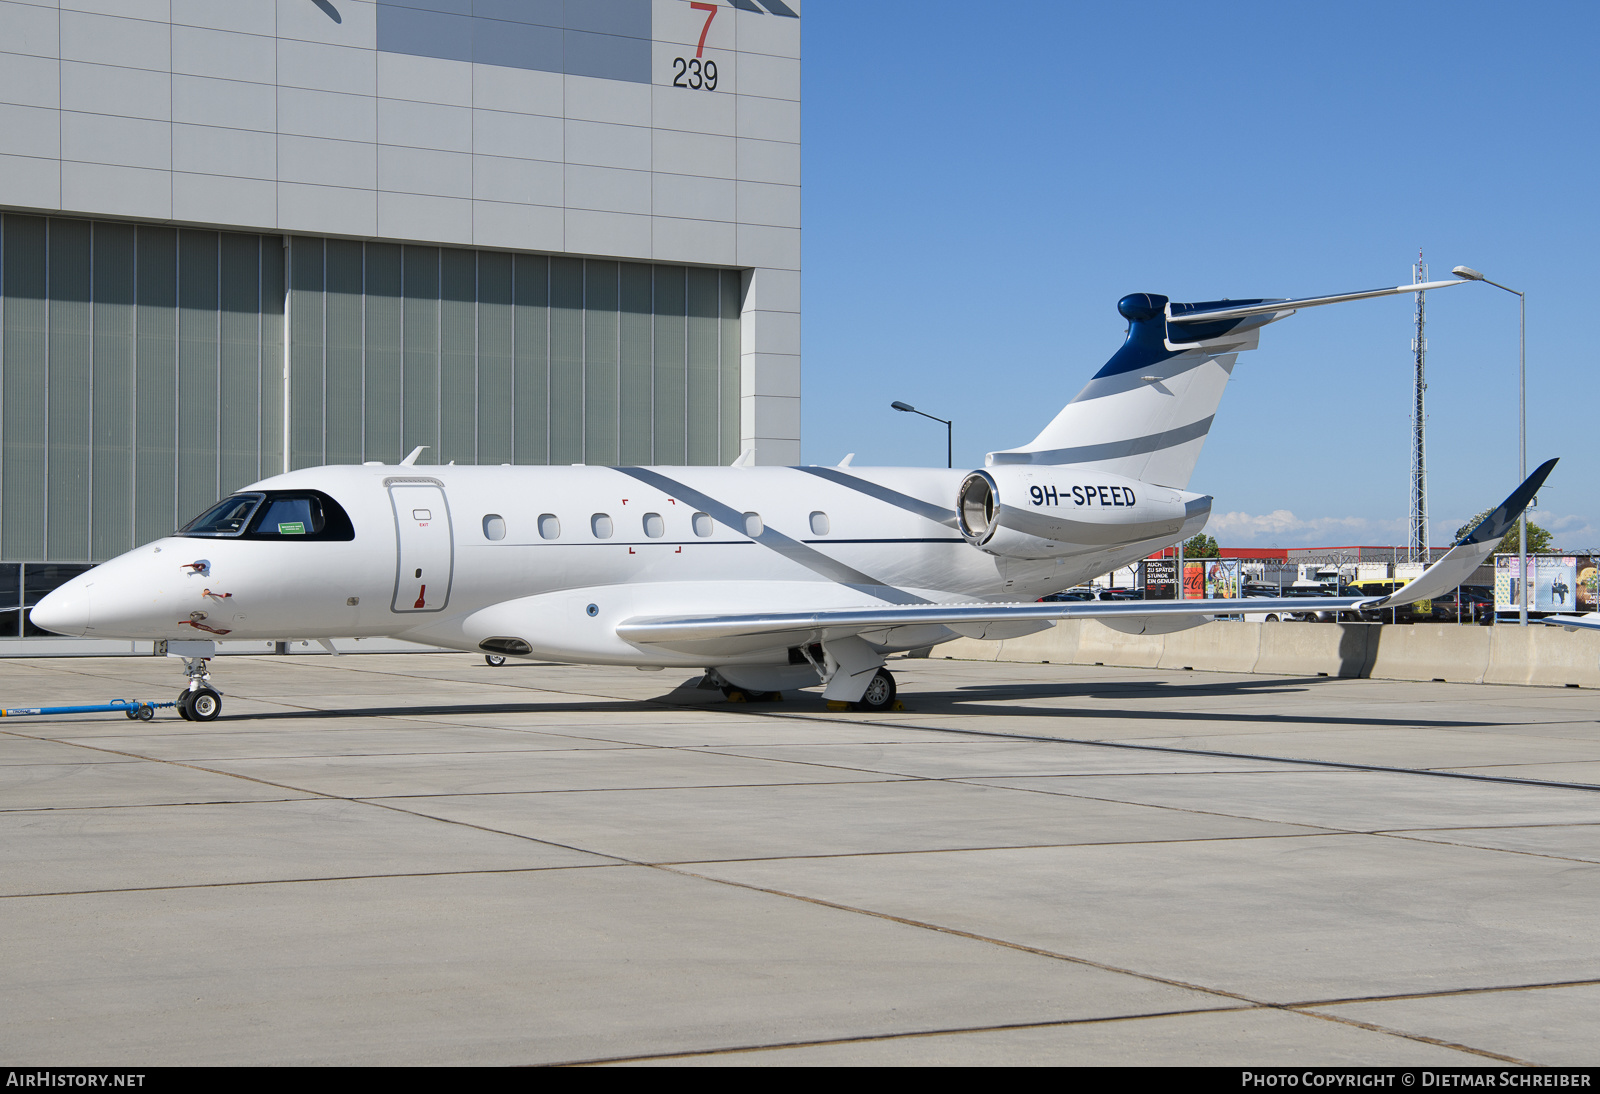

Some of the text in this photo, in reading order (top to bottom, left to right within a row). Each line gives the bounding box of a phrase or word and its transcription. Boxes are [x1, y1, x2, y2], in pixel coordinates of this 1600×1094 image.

[690, 2, 718, 58] 7
[672, 57, 718, 92] 239
[1029, 485, 1137, 507] 9H-SPEED
